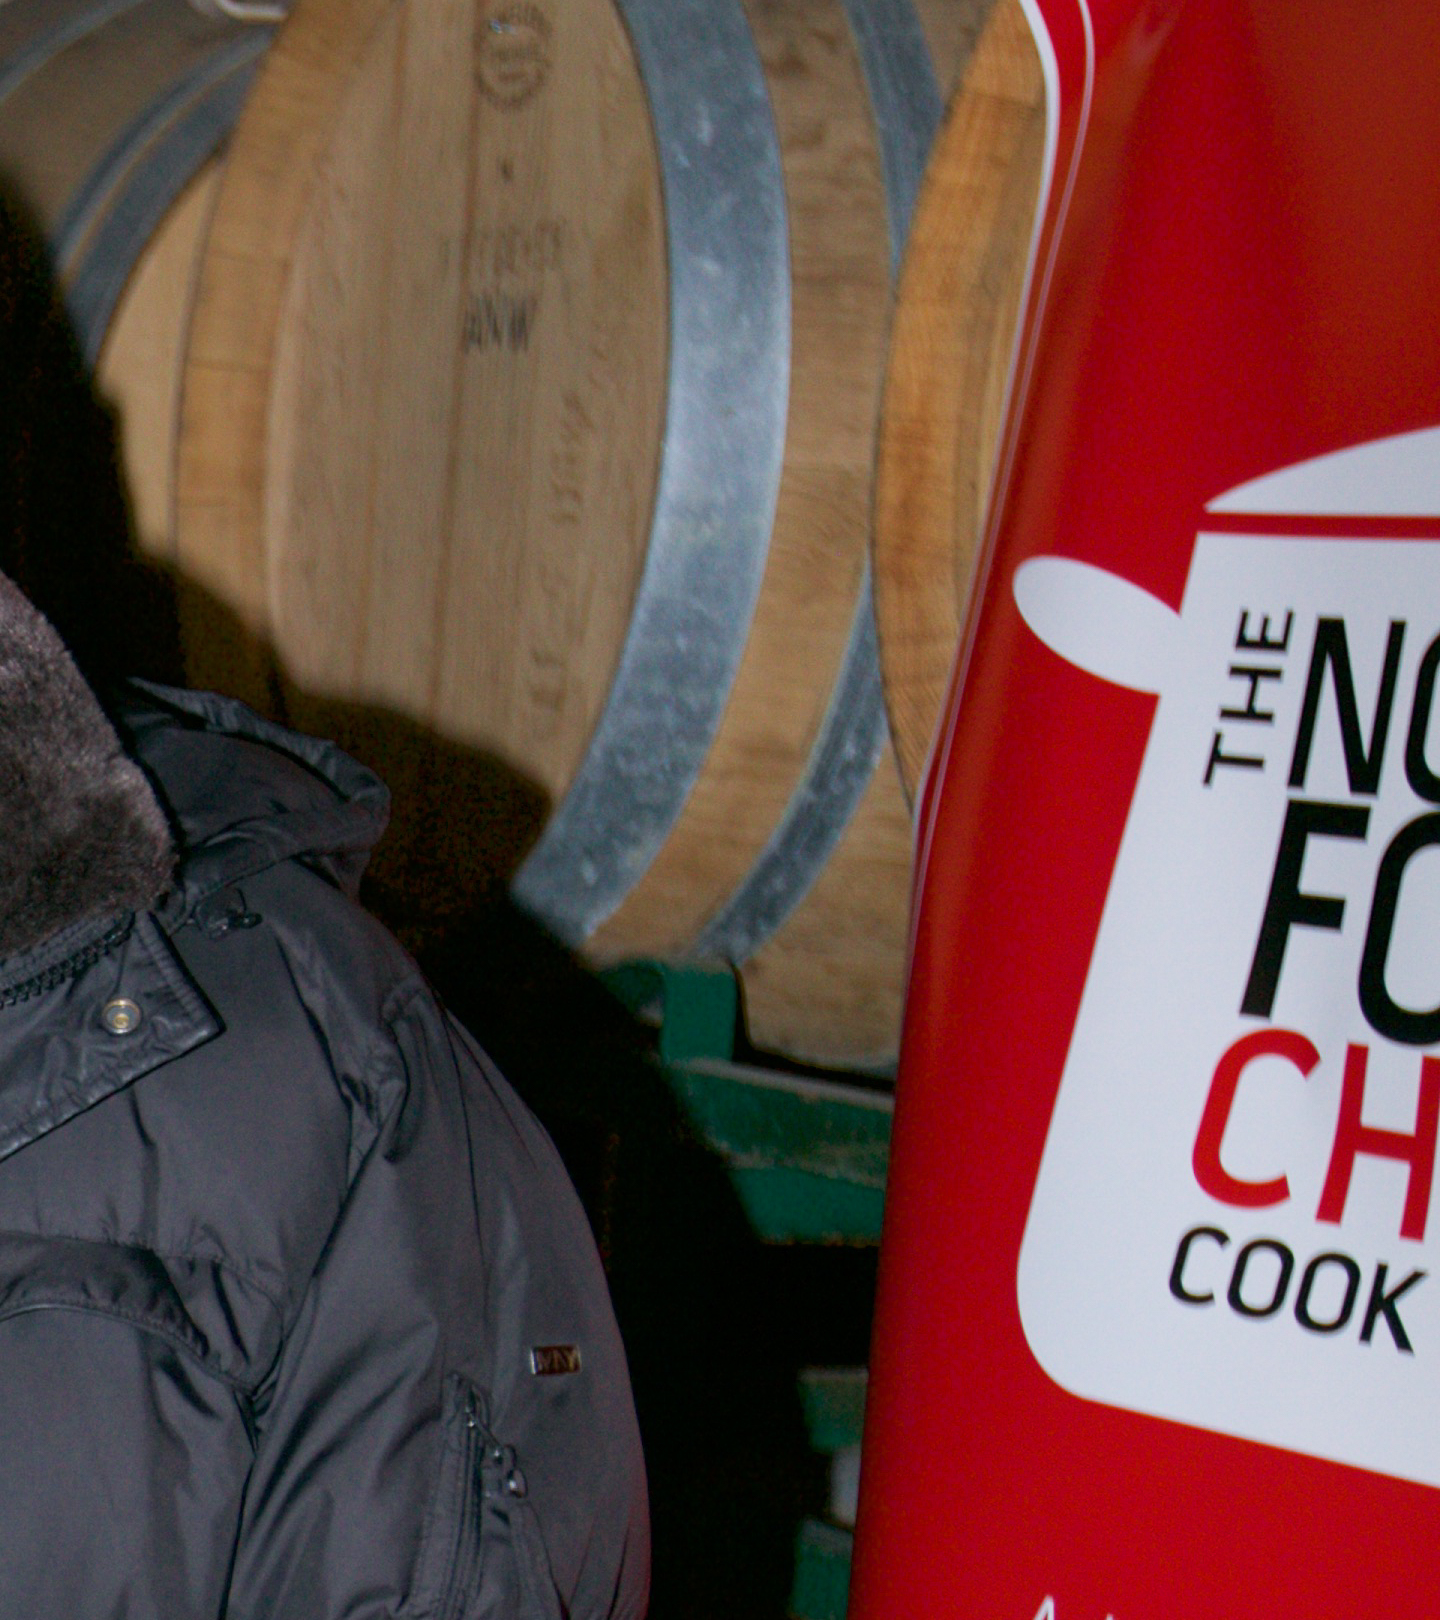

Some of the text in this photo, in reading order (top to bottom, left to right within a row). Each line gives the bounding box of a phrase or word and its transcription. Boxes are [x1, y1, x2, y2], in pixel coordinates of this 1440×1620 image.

[1202, 608, 1295, 788] THE
[1287, 614, 1440, 805] N
[1191, 1028, 1440, 1243] CH
[1168, 1224, 1429, 1357] COOK
